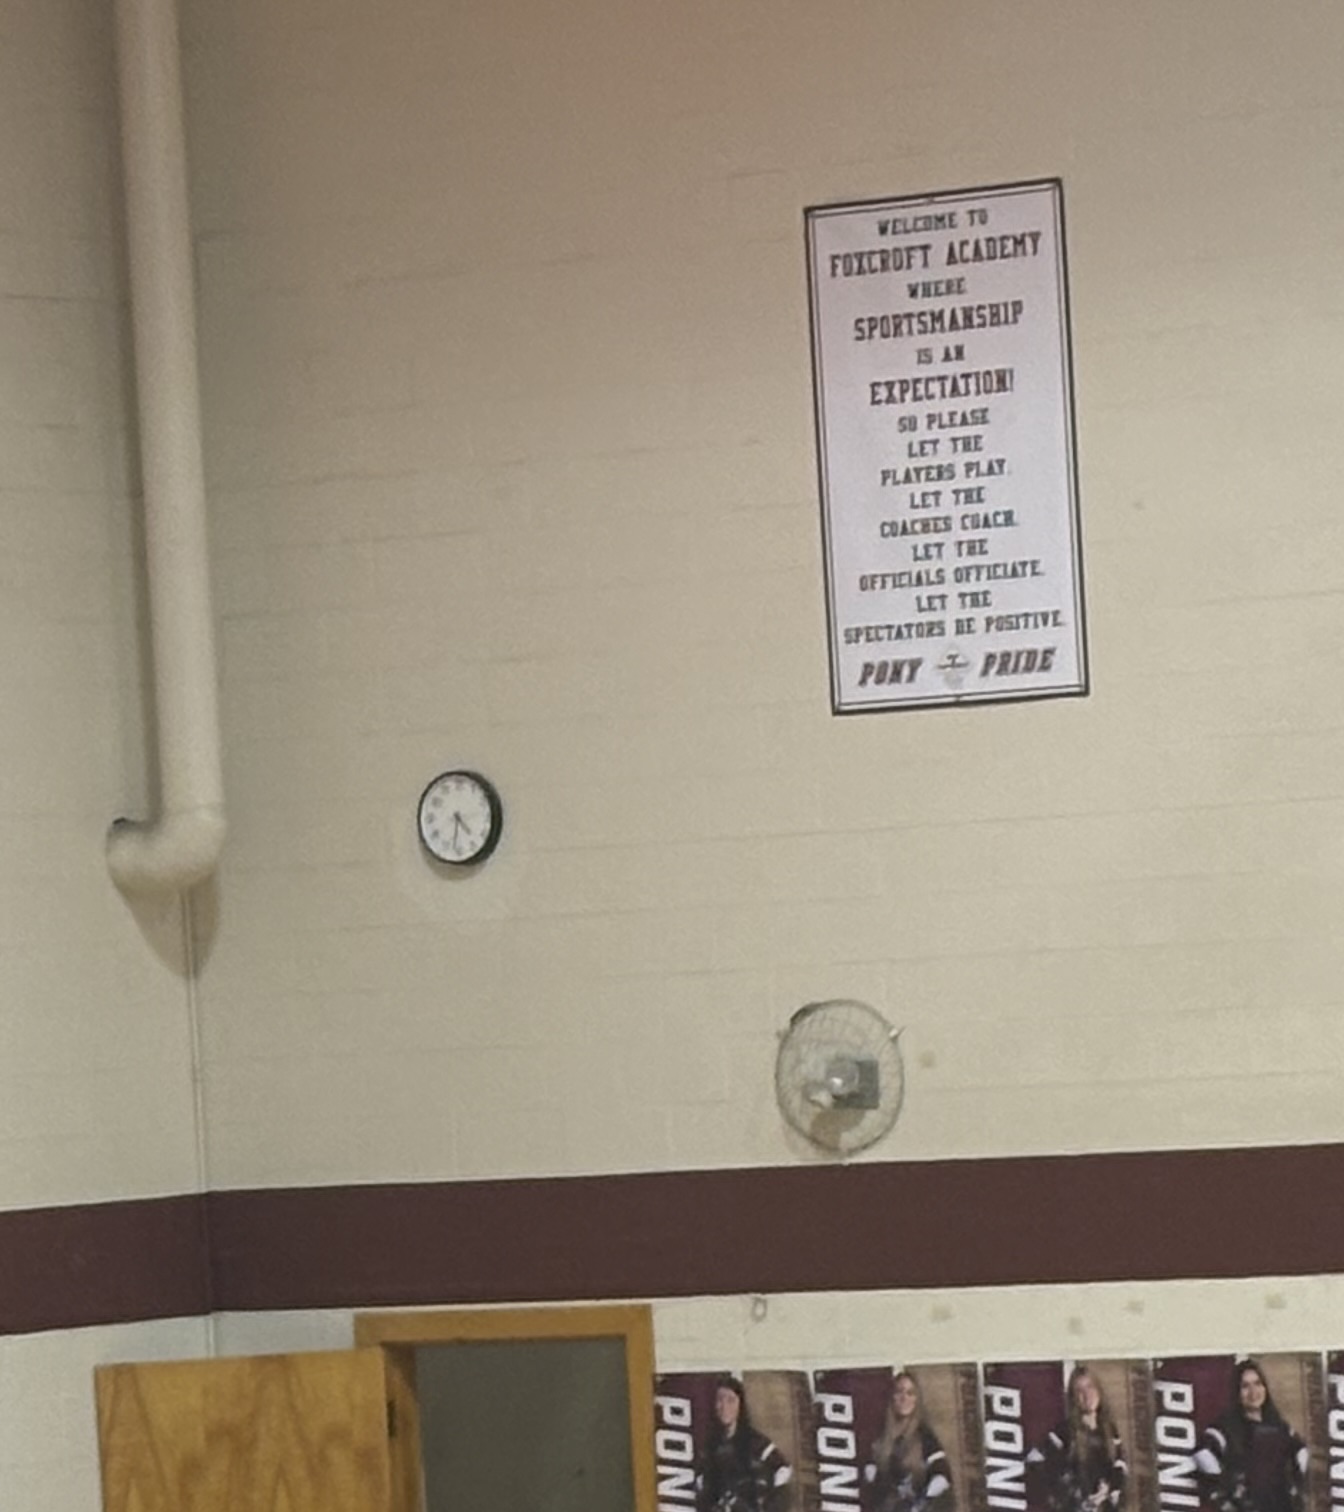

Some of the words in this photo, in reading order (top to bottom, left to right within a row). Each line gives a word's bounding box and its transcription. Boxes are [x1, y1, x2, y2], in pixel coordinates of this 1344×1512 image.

[877, 212, 958, 236] WELCOME
[966, 208, 988, 226] TO
[829, 244, 932, 278] FOXCROFT
[946, 231, 1042, 266] ACADEMY
[907, 277, 966, 299] WHERE
[854, 300, 1023, 341] SPORTSMANSHIP
[916, 348, 933, 364] IS
[941, 344, 965, 362] AN
[897, 416, 917, 433] SO
[926, 408, 990, 429] PLEASE
[908, 439, 940, 458] LET
[950, 435, 983, 453] THE
[880, 463, 956, 486] PLAYERS
[909, 491, 942, 509] LET
[952, 487, 986, 506] THE
[880, 516, 952, 538] COACHES
[911, 543, 944, 561] LET
[954, 539, 988, 558] THE
[859, 568, 945, 592] OFFICIALS
[916, 594, 948, 613] LET
[958, 590, 992, 609] THE
[844, 621, 945, 644] SPECTATORS
[955, 617, 975, 635] BE
[858, 657, 923, 687] PONY
[980, 647, 1056, 678] PRIDE
